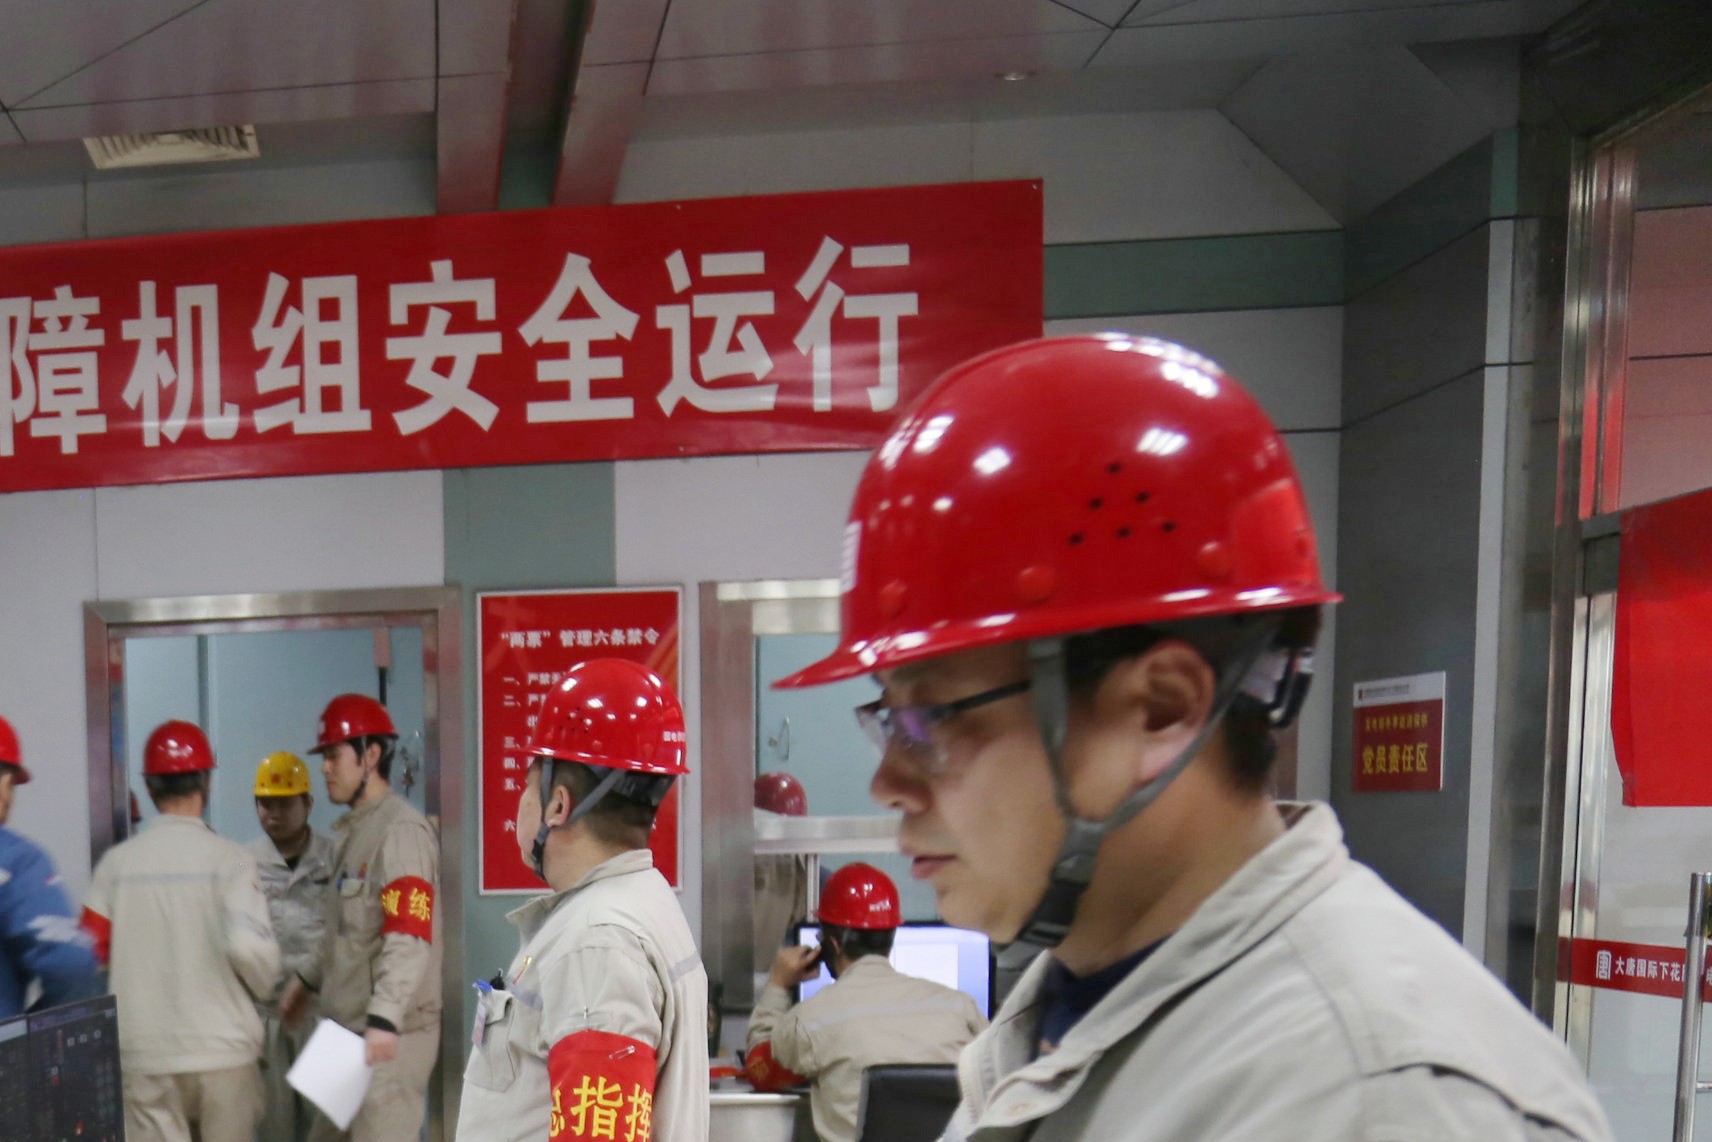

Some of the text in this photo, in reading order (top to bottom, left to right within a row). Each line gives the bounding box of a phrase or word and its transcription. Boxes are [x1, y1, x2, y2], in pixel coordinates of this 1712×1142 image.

[1362, 743, 1429, 776] 党员责任区
[1615, 956, 1686, 983] 大唐国际下花
